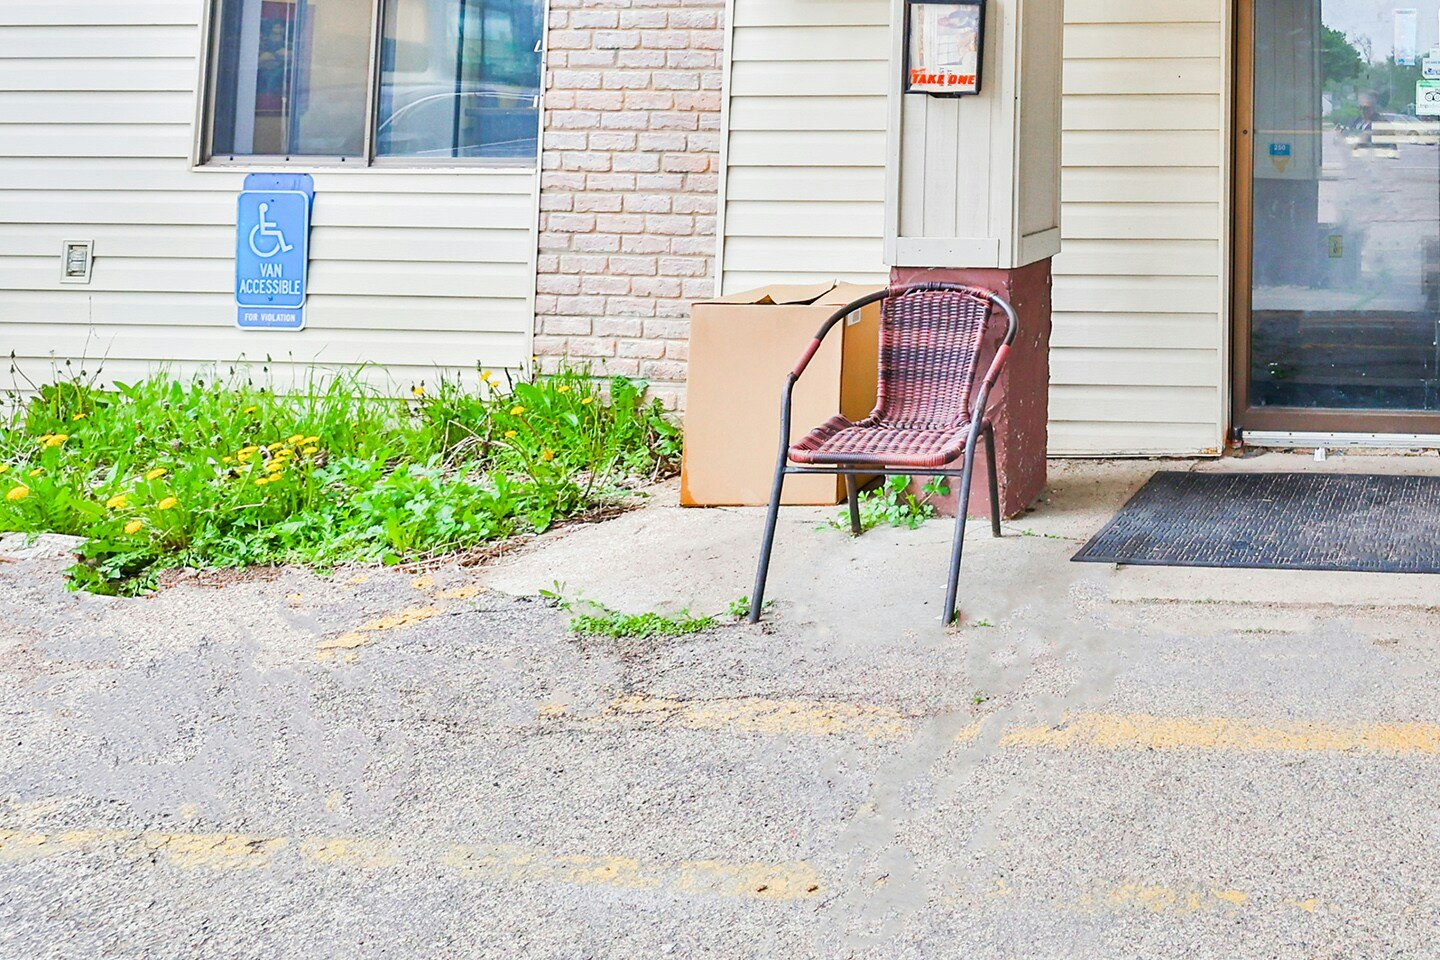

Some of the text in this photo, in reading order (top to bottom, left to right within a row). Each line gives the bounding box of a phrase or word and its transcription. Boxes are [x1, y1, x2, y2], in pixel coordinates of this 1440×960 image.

[911, 74, 976, 85] TAKE ONE
[259, 263, 282, 278] VAN
[239, 279, 301, 295] ACCESSIBLE
[244, 312, 296, 322] FOR VIOLATION
